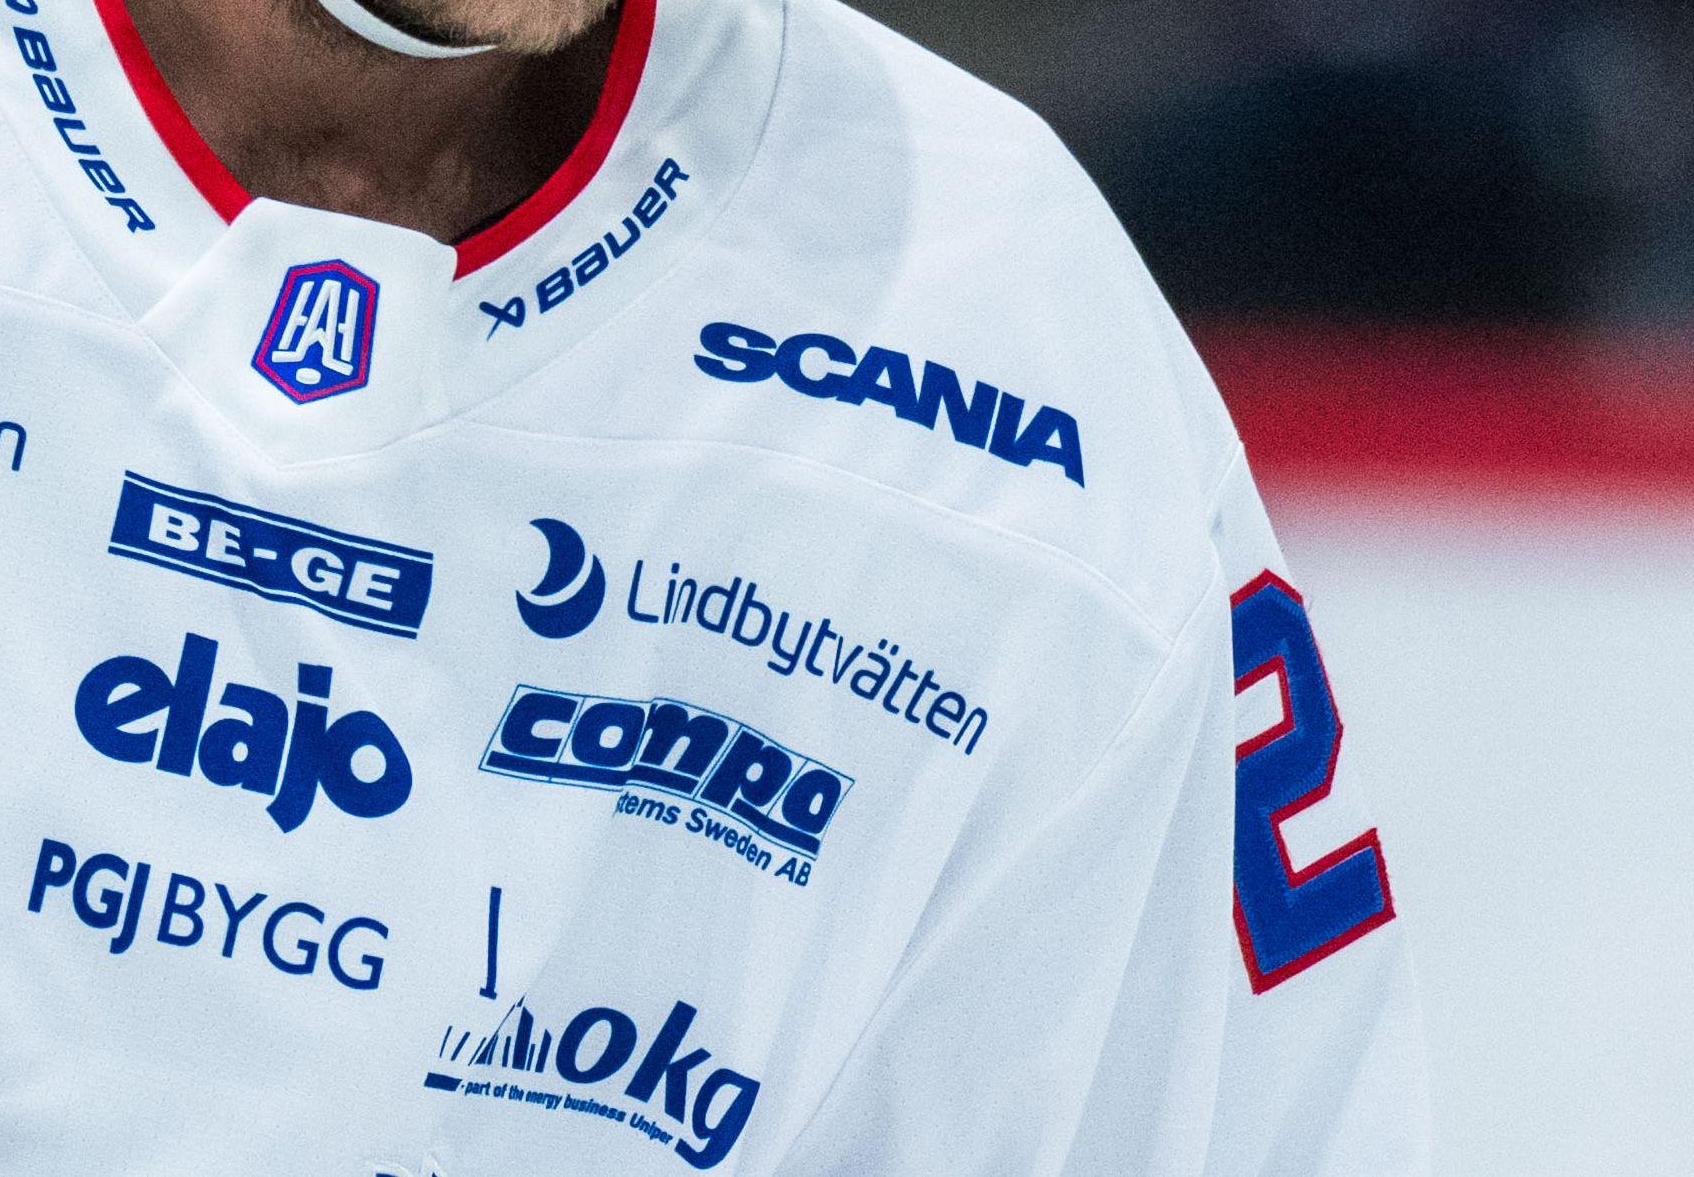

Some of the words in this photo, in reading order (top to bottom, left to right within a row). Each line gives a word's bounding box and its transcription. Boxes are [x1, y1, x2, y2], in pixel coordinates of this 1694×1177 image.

[693, 321, 1086, 489] SCANIA
[74, 632, 414, 834] elajo
[626, 558, 989, 755] Lindbytvätten
[685, 807, 772, 871] Sweden
[774, 856, 813, 887] AB
[1229, 568, 1397, 995] 2
[464, 1080, 491, 1096] part
[493, 1080, 508, 1099] of
[509, 1084, 524, 1102] the
[563, 1094, 627, 1123] business
[628, 1112, 674, 1146] Uniper
[555, 999, 761, 1170] okg
